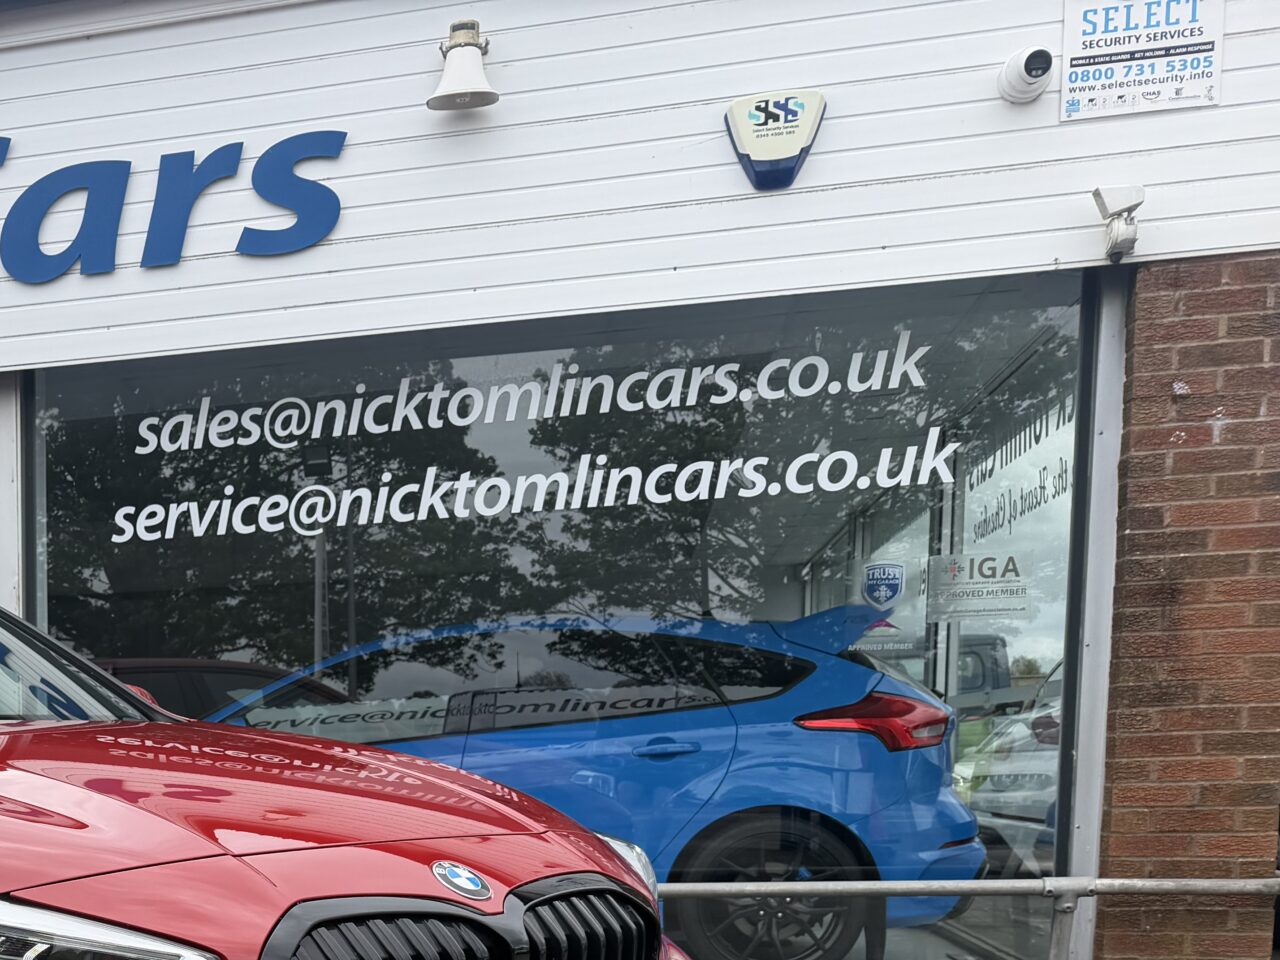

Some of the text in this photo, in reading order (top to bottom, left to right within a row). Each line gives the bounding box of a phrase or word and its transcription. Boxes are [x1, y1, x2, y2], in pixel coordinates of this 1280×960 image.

[1082, 0, 1201, 36] SELECT
[1082, 26, 1204, 50] SECURITY SERVICES
[1068, 55, 1214, 84] 0800 731 5305
[1069, 69, 1214, 94] www.selectsecurity.info
[134, 330, 932, 455] sales@nicktomlincars.co.uk
[112, 426, 961, 545] service@nicktomlincars.co.uk
[868, 567, 901, 580] TRUST
[969, 555, 1020, 580] IGA
[934, 587, 1027, 599] APPROVED MEMBER
